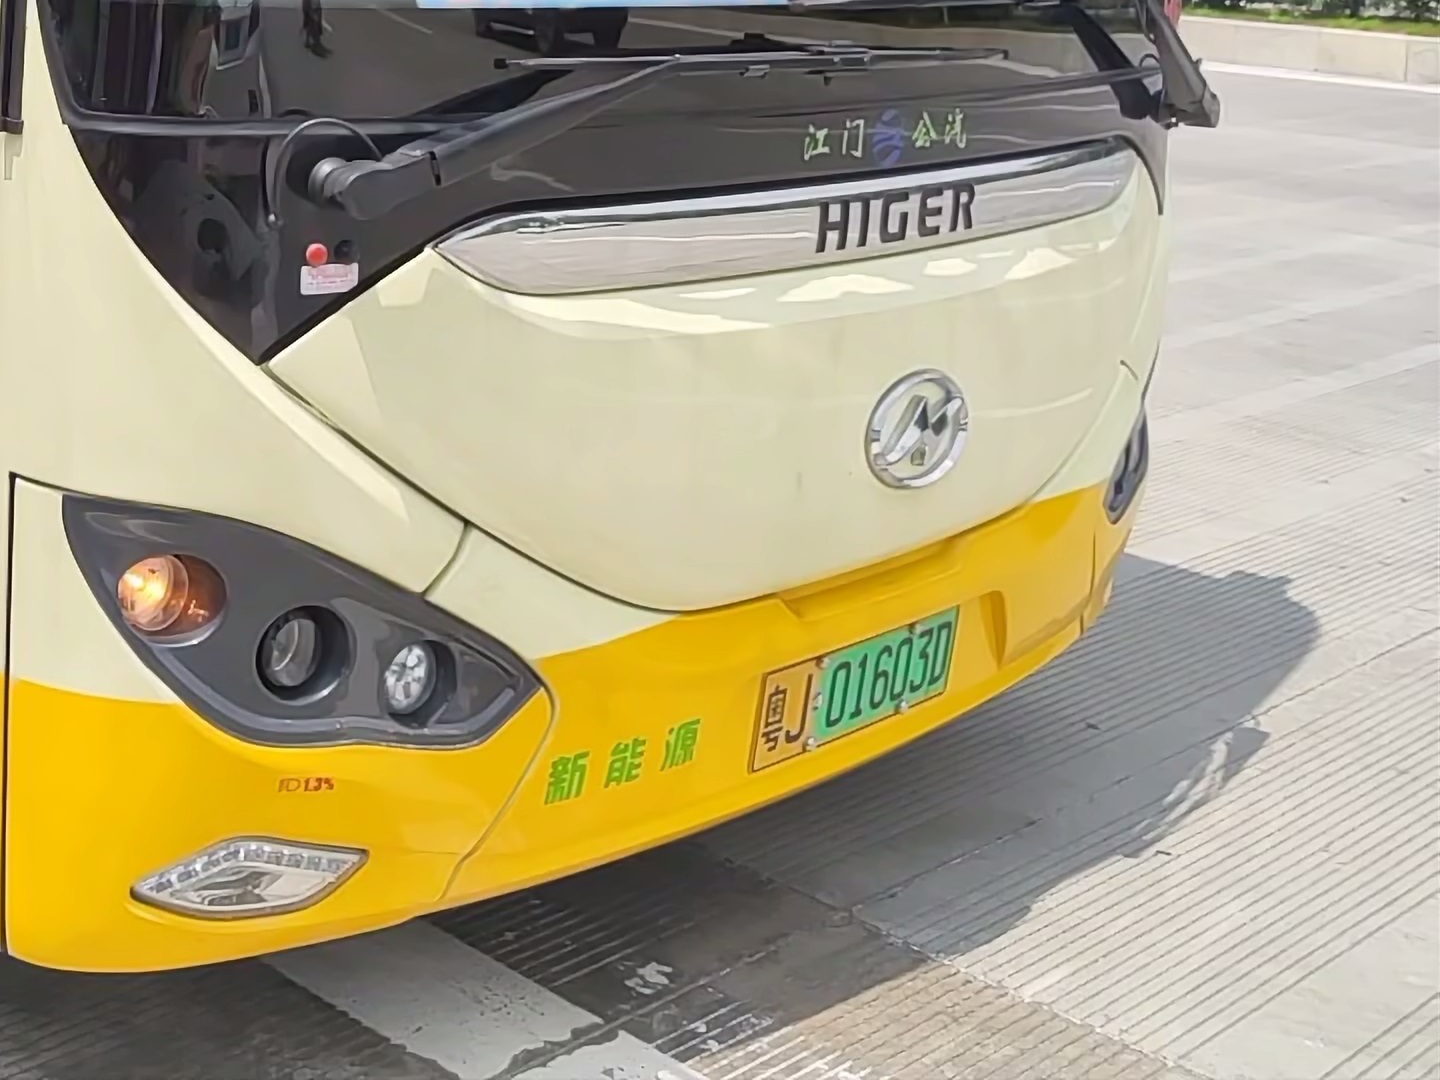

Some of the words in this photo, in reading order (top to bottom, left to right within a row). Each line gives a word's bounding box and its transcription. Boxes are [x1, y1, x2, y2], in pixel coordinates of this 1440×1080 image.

[803, 119, 865, 161] 江门
[815, 182, 976, 254] HIGER
[760, 672, 814, 753] 粤J
[824, 619, 954, 729] 01603D
[543, 718, 702, 806] 新能源
